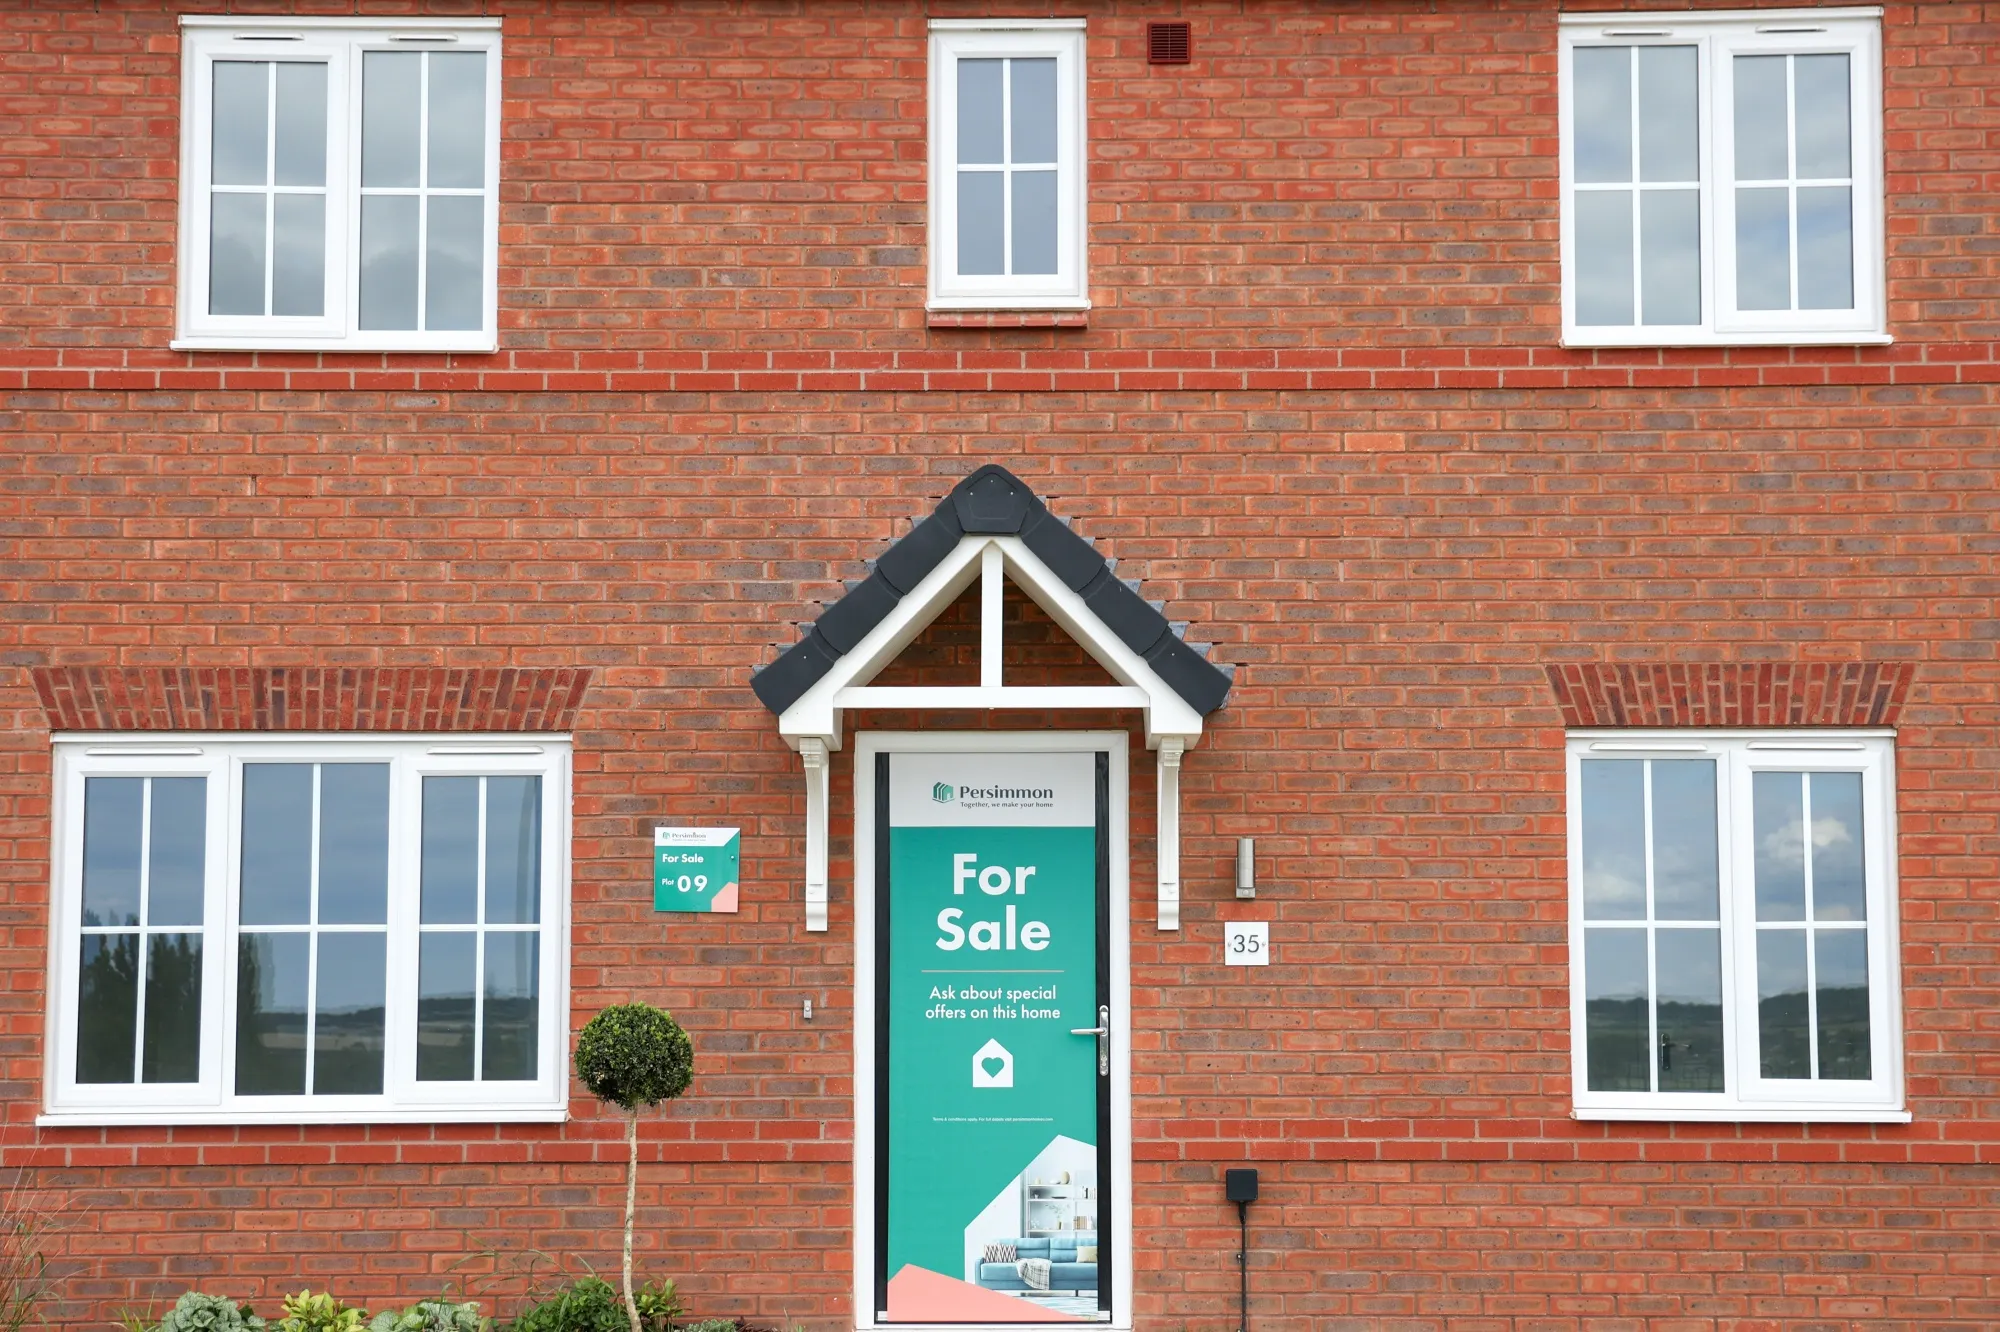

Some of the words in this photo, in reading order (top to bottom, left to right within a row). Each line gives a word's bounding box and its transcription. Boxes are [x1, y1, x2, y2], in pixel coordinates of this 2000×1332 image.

[960, 785, 1053, 799] Persimmon
[961, 801, 990, 809] Together,
[662, 853, 679, 863] For
[681, 853, 704, 863] Sale
[661, 878, 675, 886] Plot
[953, 853, 1036, 896] For
[935, 904, 1051, 951] Sale
[1233, 934, 1260, 953] 35
[929, 985, 956, 1000] Ask
[960, 984, 1003, 1000] about
[1006, 985, 1057, 1003] special
[925, 1004, 966, 1019] offers
[970, 1009, 989, 1019] on
[993, 1004, 1017, 1019] this
[1021, 1004, 1061, 1019] home
